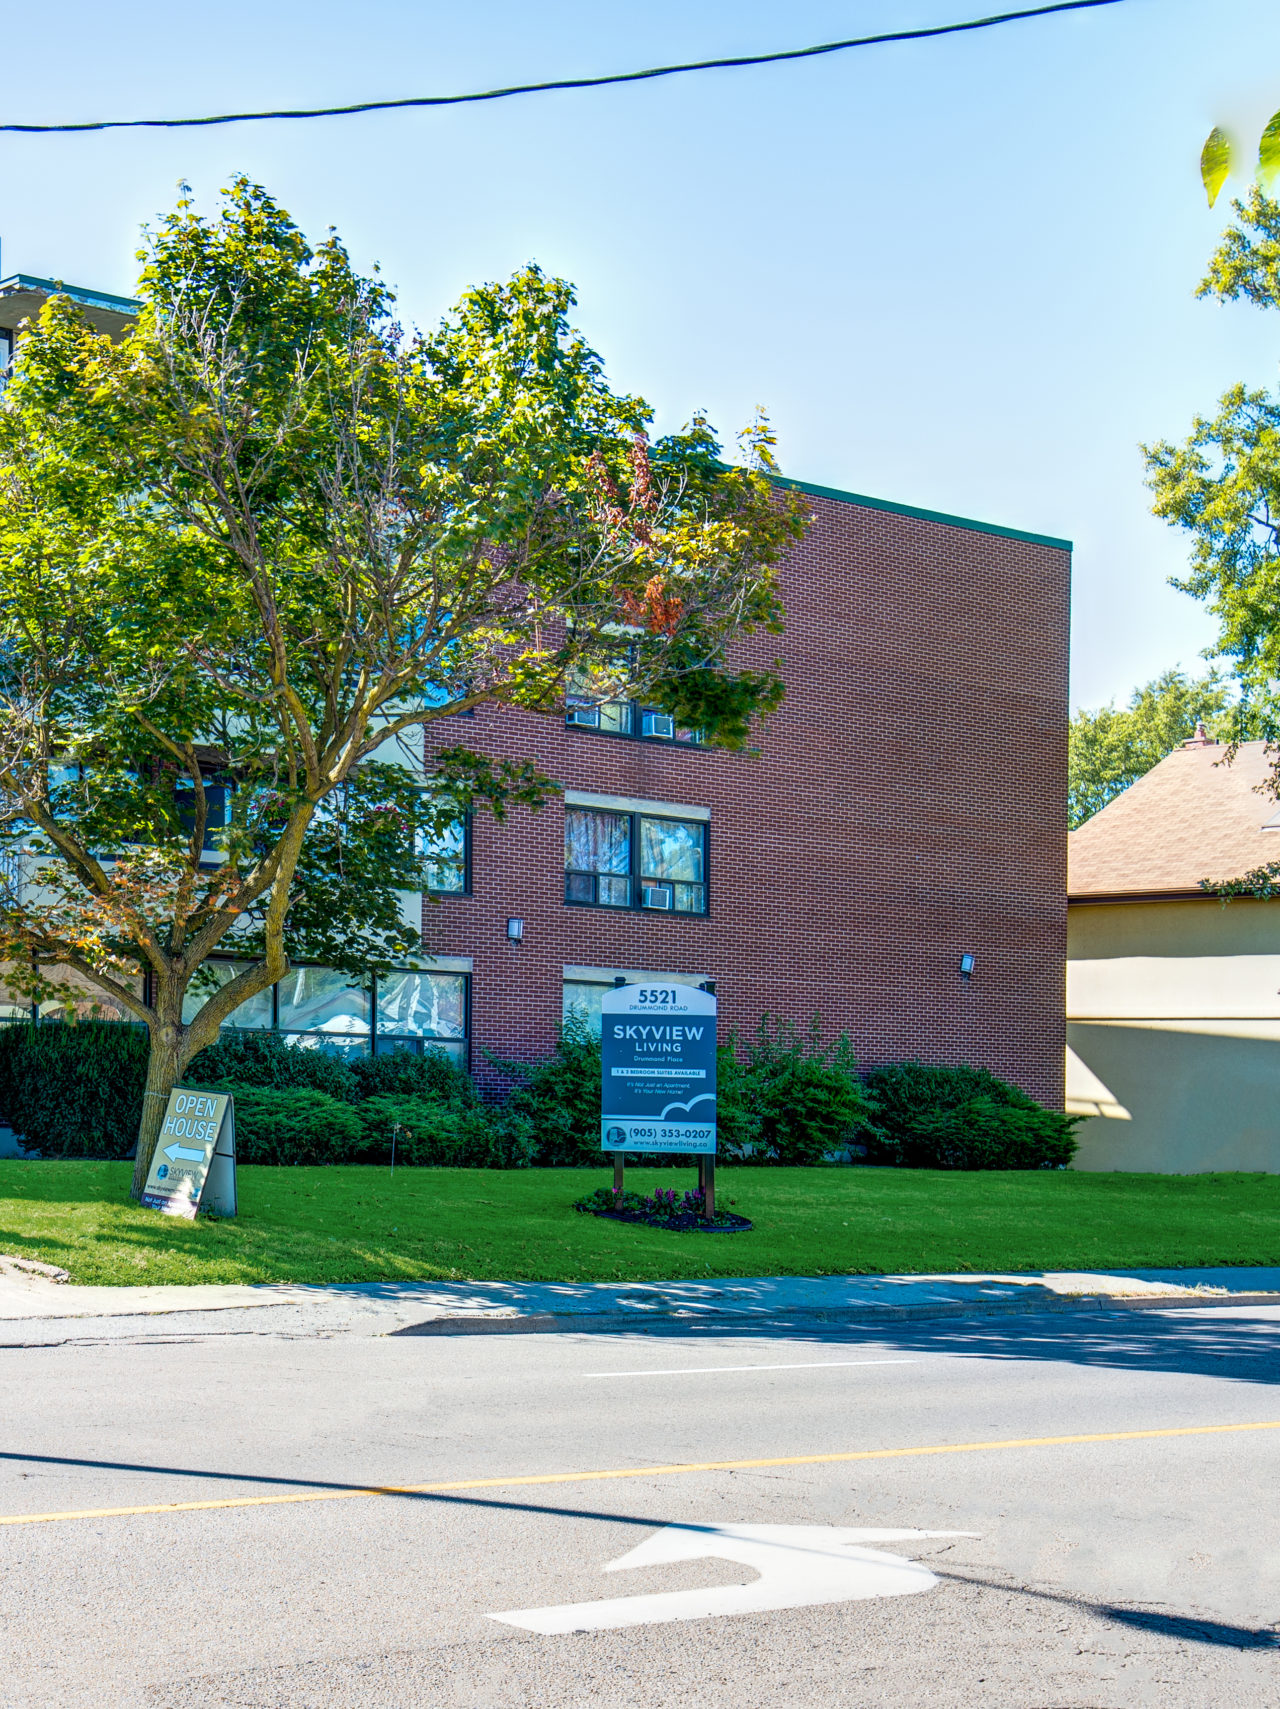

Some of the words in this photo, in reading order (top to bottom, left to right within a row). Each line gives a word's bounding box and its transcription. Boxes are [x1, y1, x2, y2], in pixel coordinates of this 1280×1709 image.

[638, 989, 677, 1004] 5521
[613, 1025, 704, 1040] SKYVIEW
[635, 1042, 681, 1052] LIVING
[175, 1094, 218, 1118] OPEN
[163, 1115, 217, 1141] HOUSE
[629, 1128, 657, 1138] (905)
[661, 1128, 711, 1139] 353-0207
